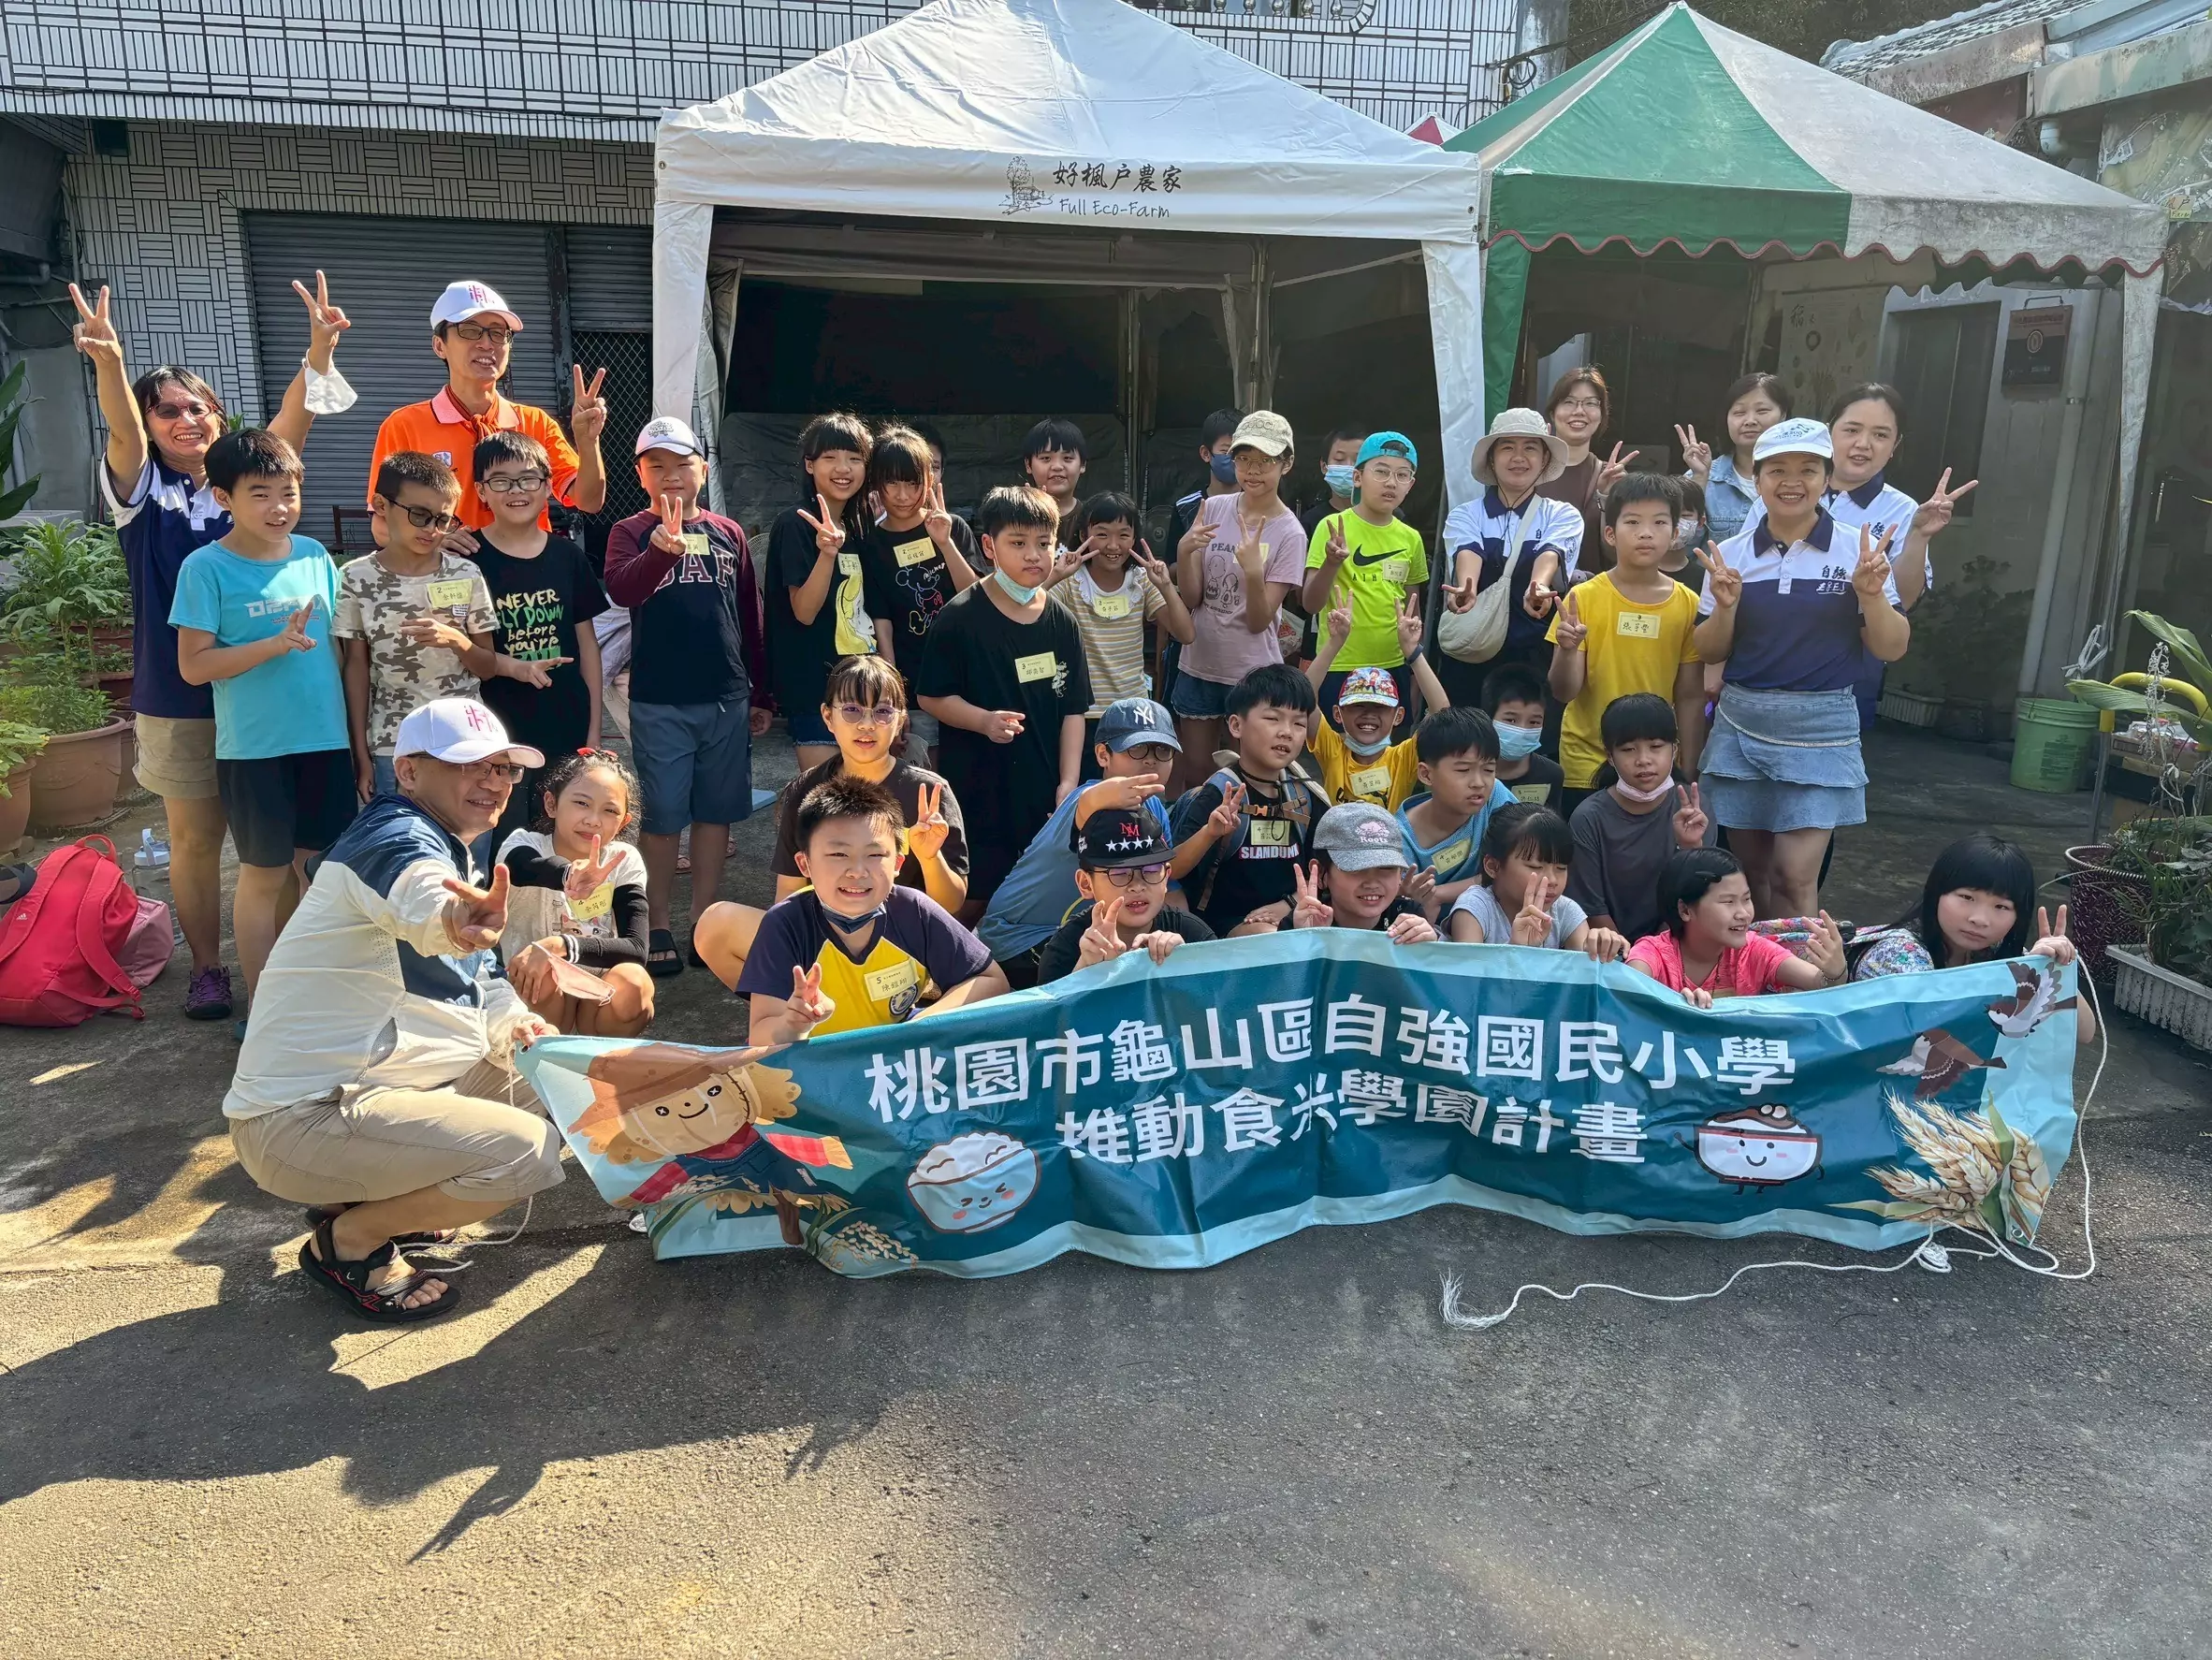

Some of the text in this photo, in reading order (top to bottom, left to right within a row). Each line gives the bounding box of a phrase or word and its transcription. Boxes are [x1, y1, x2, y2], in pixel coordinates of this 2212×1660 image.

[1059, 198, 1170, 219] Full Eco-Farm
[654, 545, 735, 588] AP
[1821, 564, 1847, 580] 自強
[496, 589, 560, 610] NEVER
[523, 604, 563, 626] DOWN
[508, 624, 557, 642] before
[1133, 706, 1156, 725] NY
[864, 993, 1797, 1124] 桃園市龜山區自強國民小學
[1055, 1068, 1648, 1164] 推動食米學園計畫
